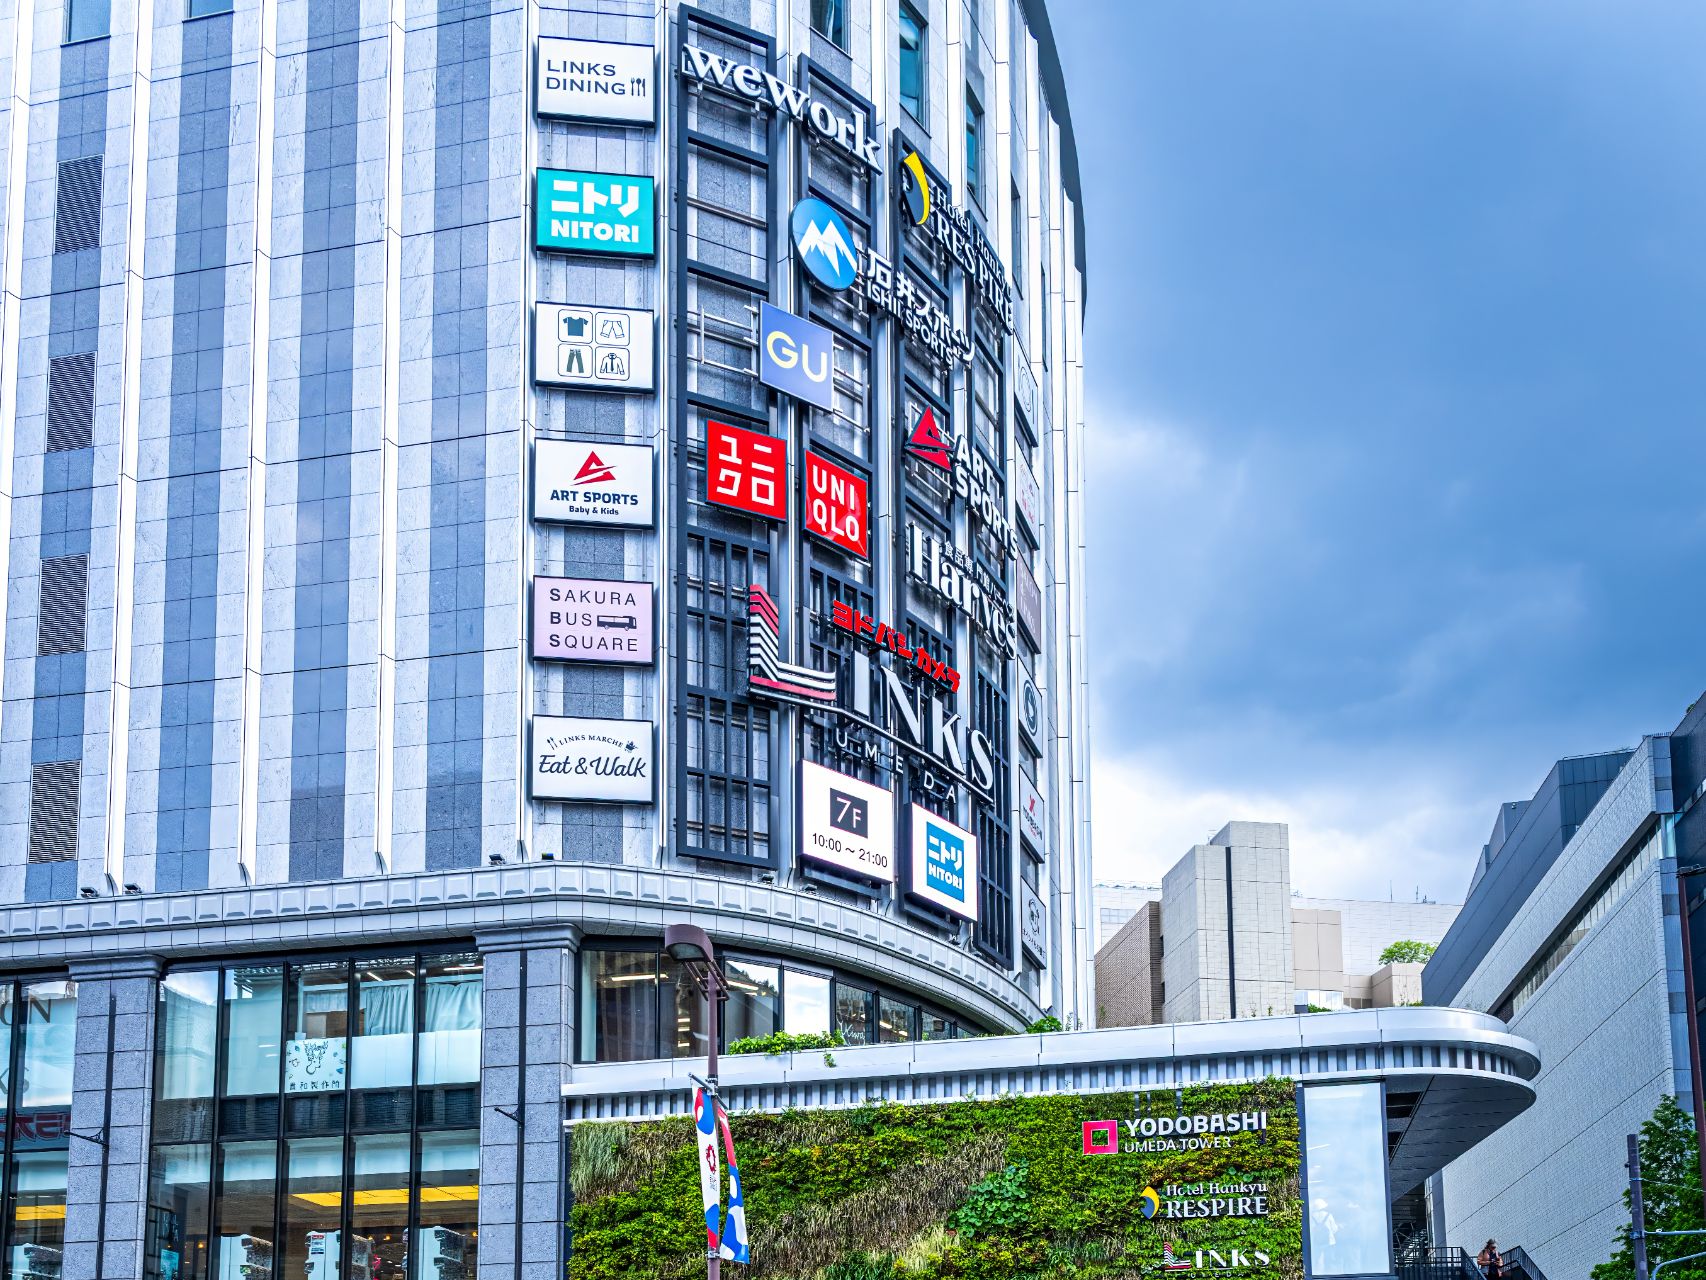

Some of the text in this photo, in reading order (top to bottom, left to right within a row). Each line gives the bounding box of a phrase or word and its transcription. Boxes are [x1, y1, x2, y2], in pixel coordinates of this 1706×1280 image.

[547, 59, 616, 77] LINKS
[546, 77, 626, 95] DINING
[683, 43, 883, 175] wework
[551, 179, 639, 218] ニトリ
[936, 189, 971, 238] Hotel
[551, 219, 639, 243] NITORI
[935, 210, 1013, 330] RESPIRE
[867, 248, 976, 361] 石井スポーツ
[867, 279, 954, 370] ISHII SPORTS
[766, 330, 828, 383] GU
[955, 434, 997, 495] ART
[550, 489, 639, 506] ART SPORTS
[812, 465, 855, 511] UNI
[569, 505, 619, 516] Baby & Kids
[812, 499, 860, 542] QLO
[955, 463, 1018, 560] SPORTS
[550, 588, 637, 606] SAKURA
[907, 521, 1017, 660] Harves
[550, 611, 593, 627] BUS
[549, 634, 638, 652] SQUARE
[833, 599, 961, 694] ヨドバシカメラ
[559, 734, 624, 748] LINKS MARCHE
[835, 729, 956, 804] UMEDA
[836, 797, 862, 828] 7F
[812, 832, 842, 853] 10:00
[859, 848, 888, 868] 21:00
[928, 835, 963, 871] ニトリ
[928, 864, 963, 890] NITORI
[1125, 1111, 1267, 1137] YODOBASHI
[1124, 1136, 1232, 1153] UMEDA TOWER
[1166, 1182, 1267, 1197] Hotel Hankyu
[1166, 1196, 1269, 1219] RESPIRE
[1163, 1241, 1270, 1271] LINKS
